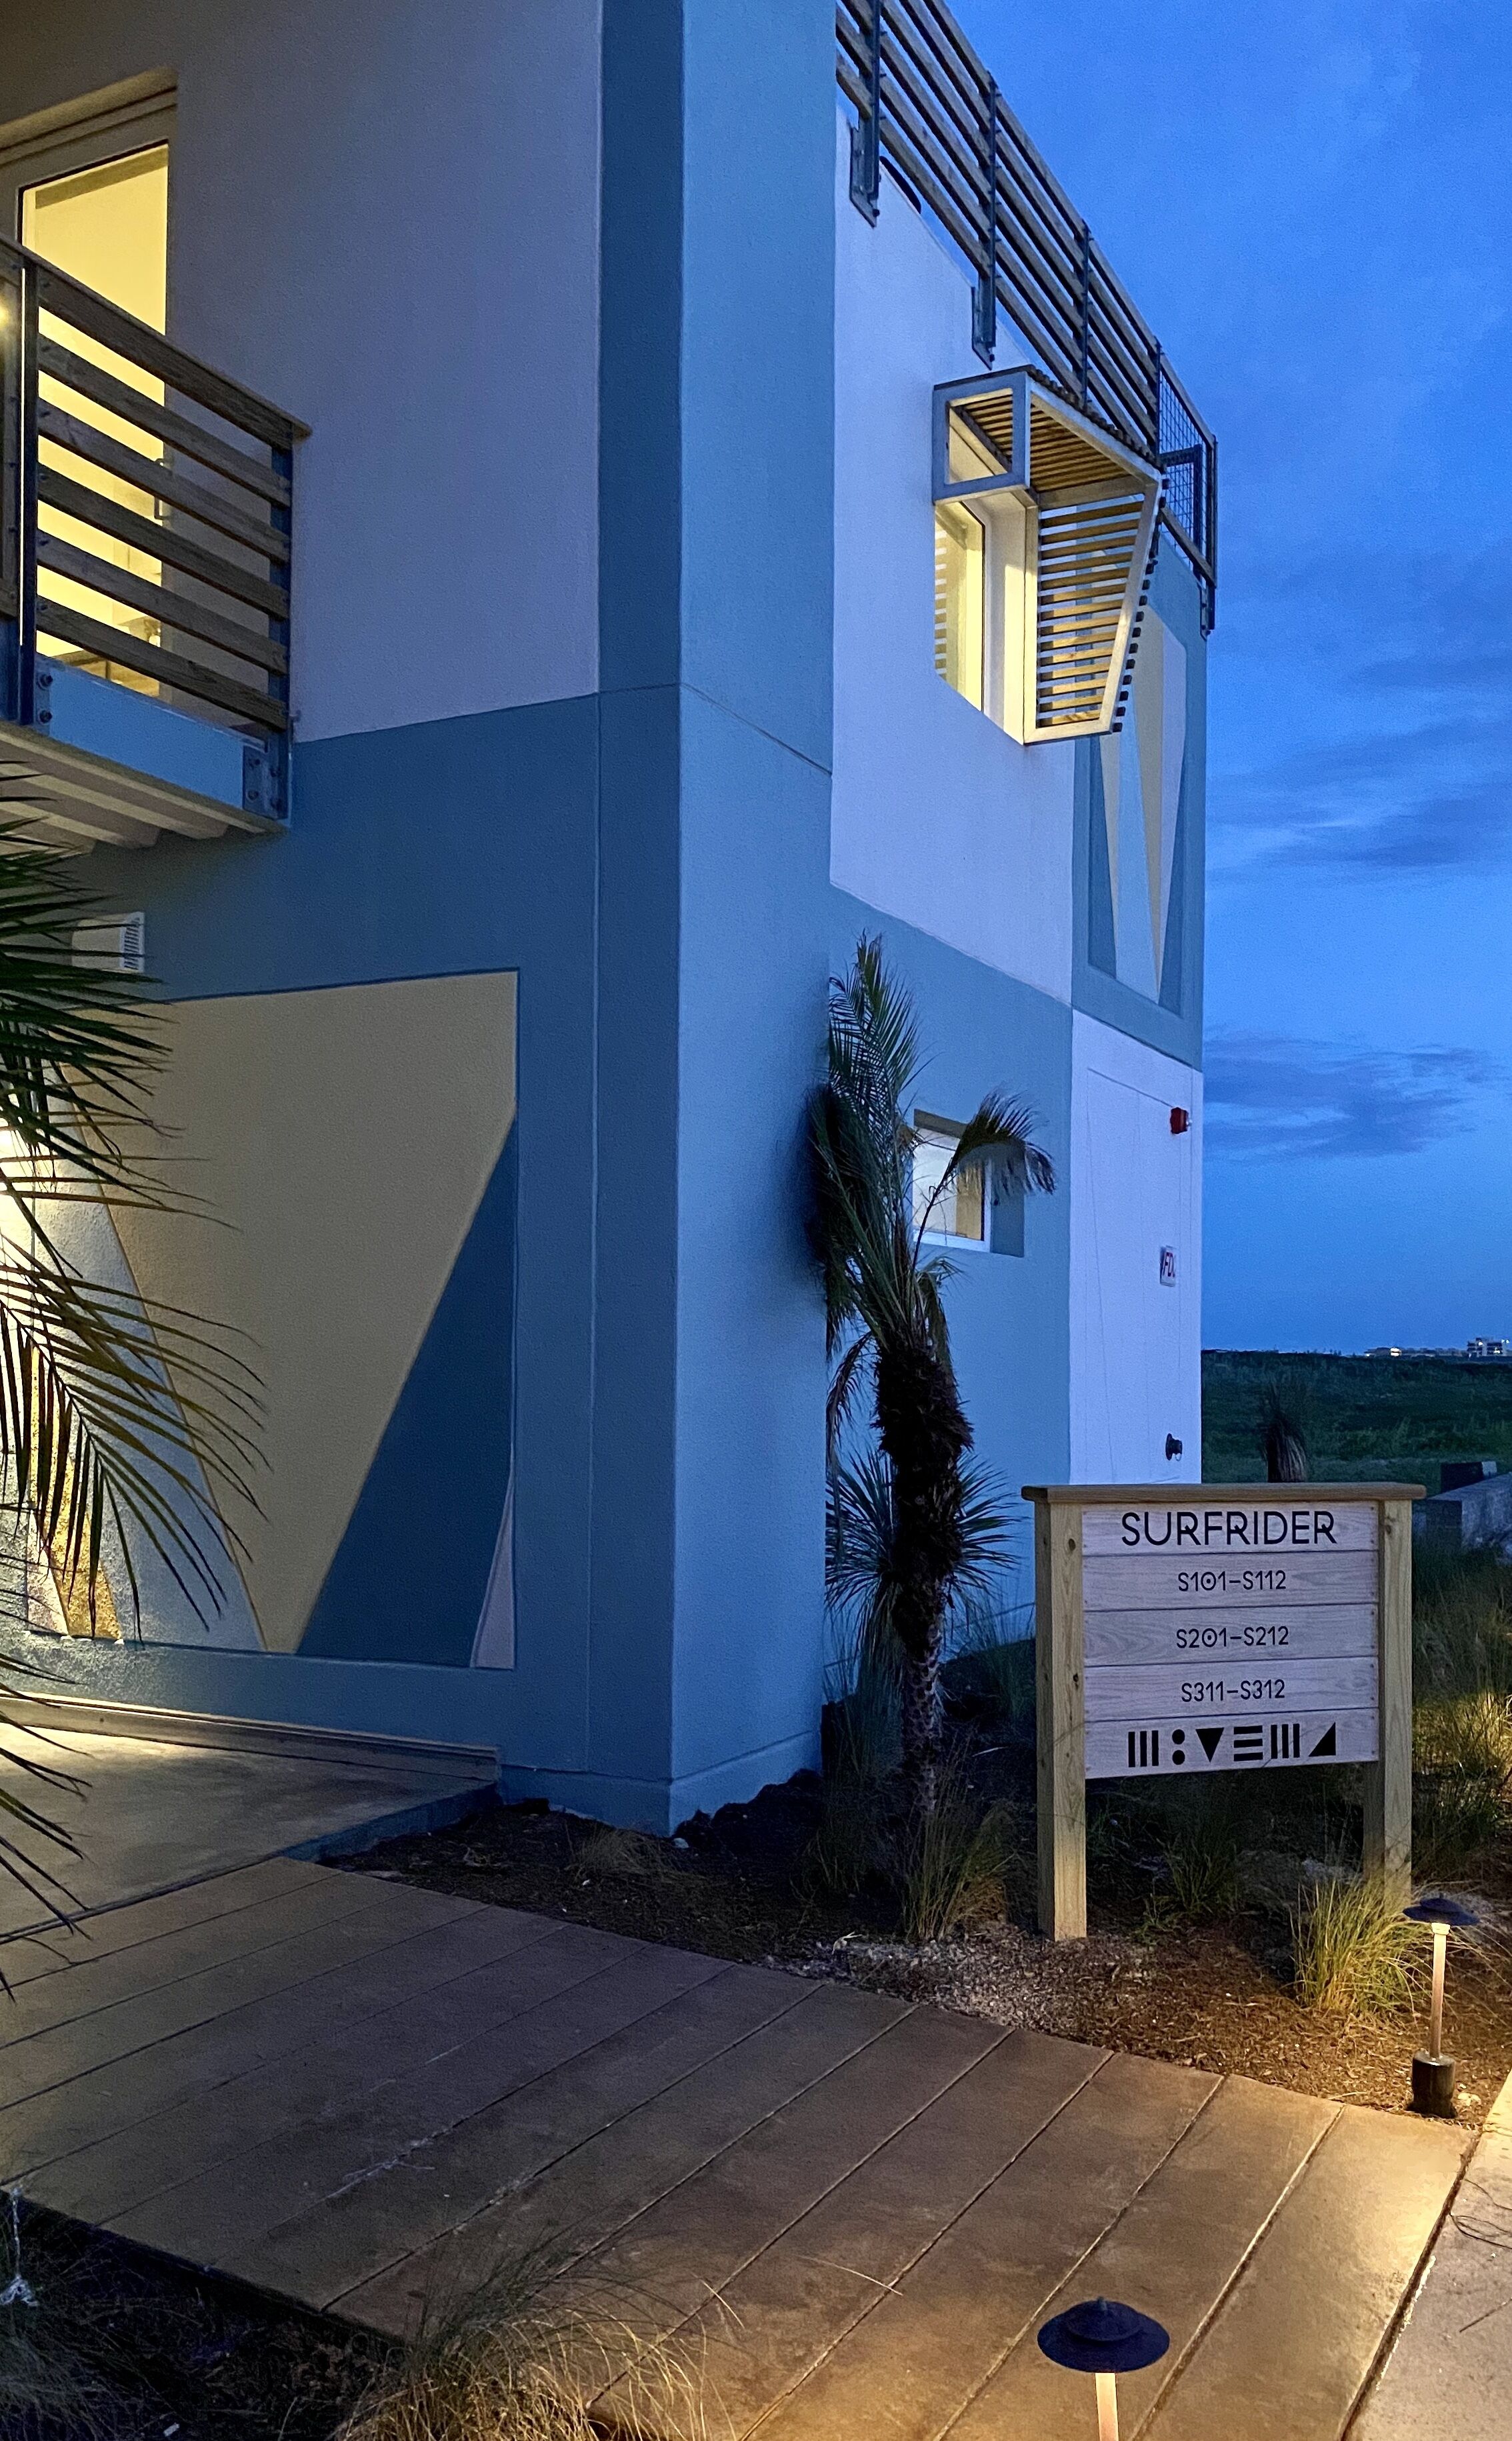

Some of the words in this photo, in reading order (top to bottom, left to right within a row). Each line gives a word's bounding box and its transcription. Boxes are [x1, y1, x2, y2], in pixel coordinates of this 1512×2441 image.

[1121, 1510, 1337, 1546] SURFRIDER
[1177, 1570, 1287, 1592] S101-S112
[1175, 1626, 1289, 1649] S201-S212
[1181, 1678, 1285, 1703] S311-S312
